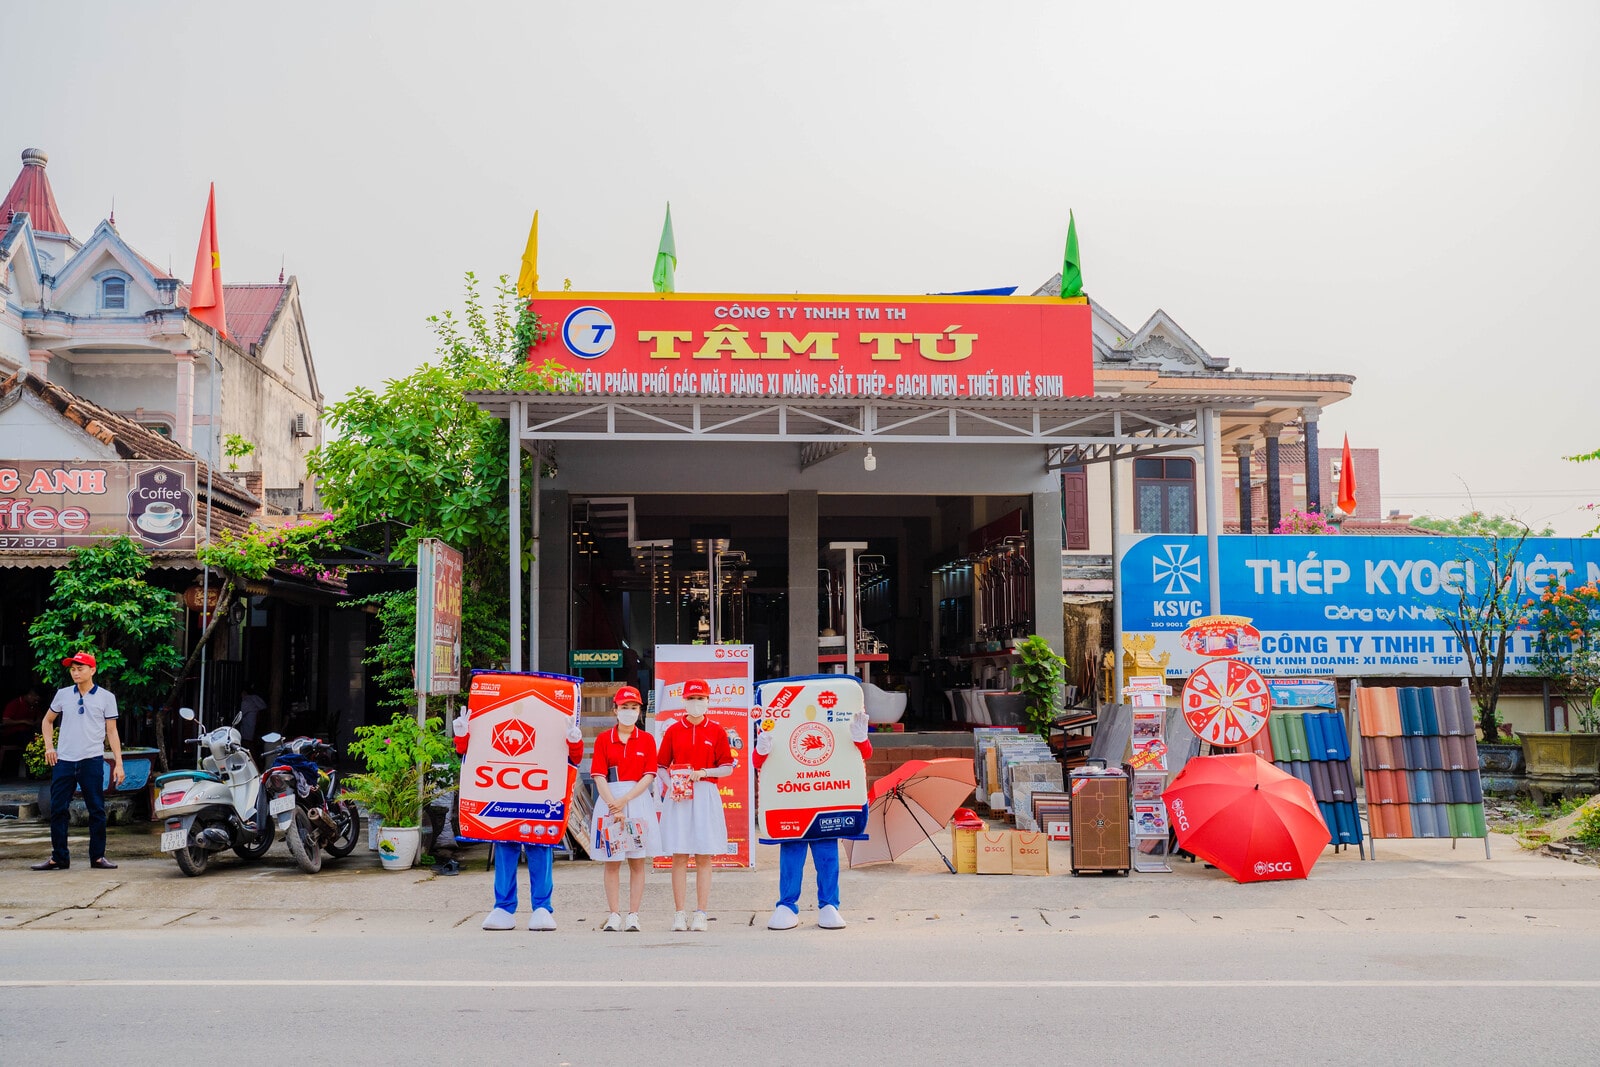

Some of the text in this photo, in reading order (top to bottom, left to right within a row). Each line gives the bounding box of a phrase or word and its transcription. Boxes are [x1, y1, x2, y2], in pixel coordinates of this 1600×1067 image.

[714, 303, 906, 320] CÔNG TY TNHH TM TH
[638, 323, 979, 362] TÂM TÚ
[604, 367, 638, 393] PHÂN
[641, 365, 671, 394] PHỐI
[673, 368, 698, 394] CÁC
[730, 368, 764, 394] HÀNG
[767, 373, 780, 394] XI
[782, 369, 819, 394] MĂNG
[829, 366, 852, 395] SẮT
[856, 369, 886, 395] THÉP
[930, 374, 958, 396] MEN
[967, 368, 999, 396] THIẾT
[1034, 375, 1064, 398] SINH
[26, 469, 108, 494] ANH
[139, 486, 182, 500] Coffee
[1245, 550, 1351, 595] THÉP
[1153, 600, 1203, 617] KSVC
[1324, 604, 1374, 622] Công
[1375, 606, 1397, 622] ty
[1261, 632, 1328, 654] CÔNG
[1335, 636, 1364, 654] TY
[1371, 636, 1435, 654] TNHH
[573, 653, 619, 662] MIKADO
[727, 649, 749, 658] SCG
[1275, 657, 1307, 665] KINH
[1310, 656, 1359, 665] DOANH:
[1363, 656, 1376, 665] XI
[1380, 655, 1419, 665] MĂNG
[1431, 655, 1464, 665] THÉP
[765, 708, 791, 719] SCG
[474, 765, 549, 791] SCG
[776, 779, 851, 793] SÔNG GIANH
[494, 805, 518, 813] SUPER
[1175, 809, 1190, 832] SCG
[1267, 862, 1293, 873] SCG
